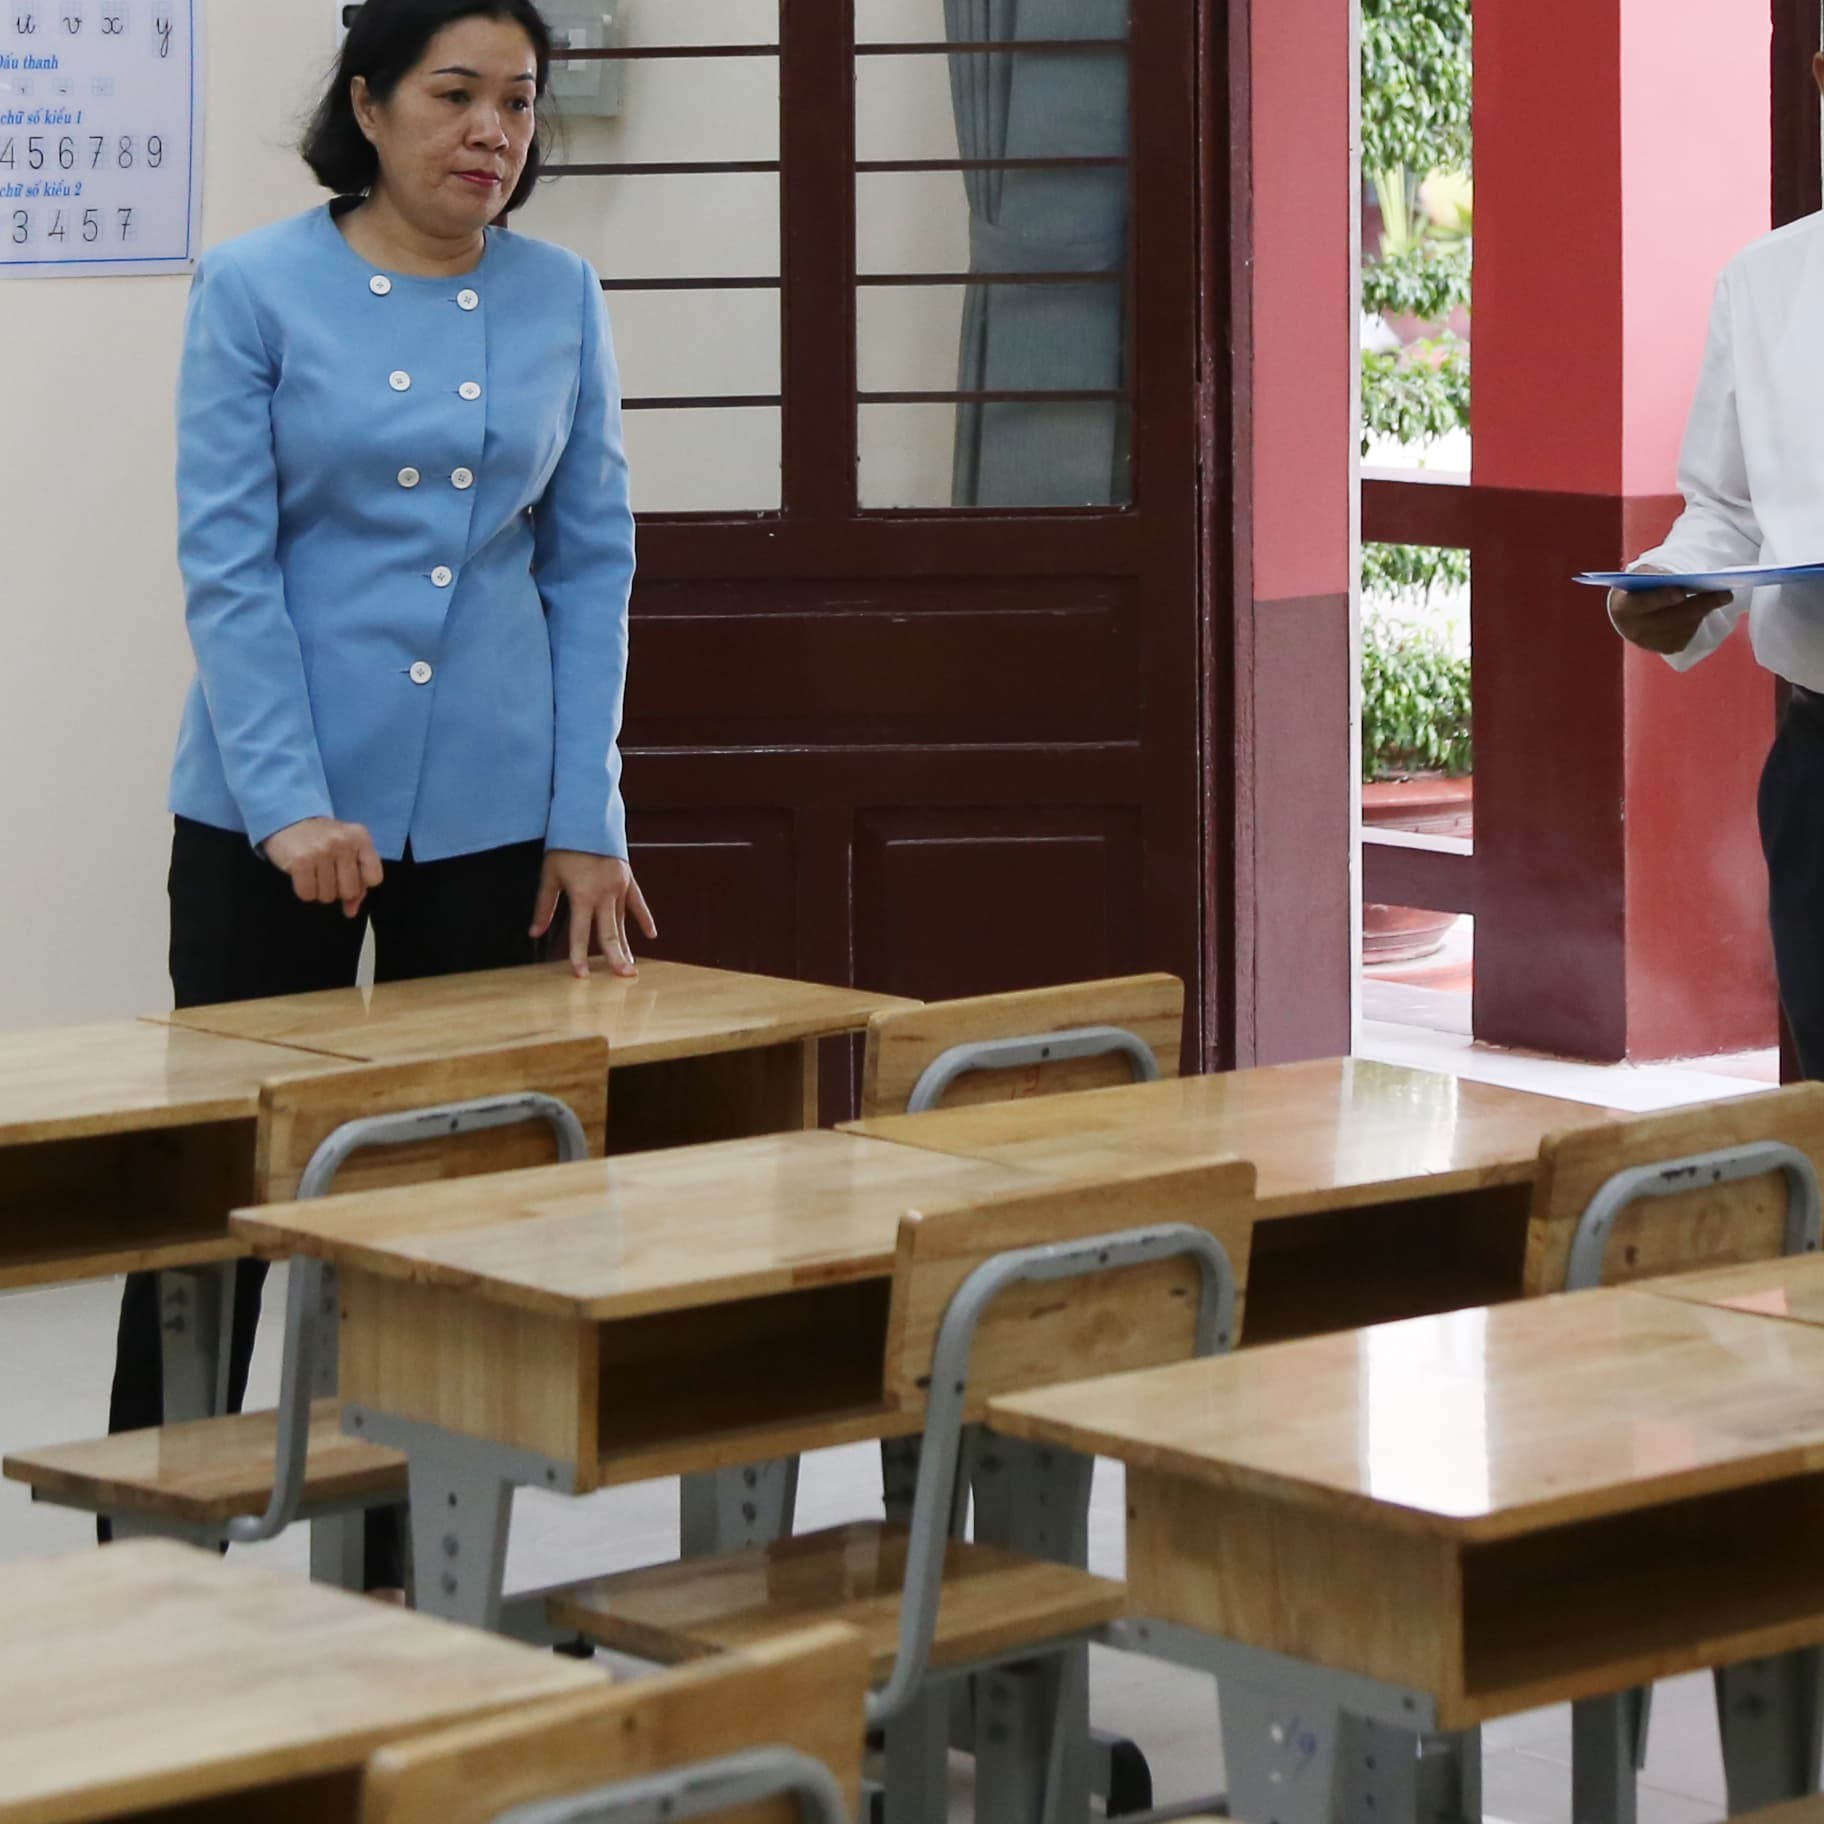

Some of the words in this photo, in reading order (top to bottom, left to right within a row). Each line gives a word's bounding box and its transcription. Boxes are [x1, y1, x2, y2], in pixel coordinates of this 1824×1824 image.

[23, 55, 59, 70] thanh
[28, 136, 44, 170] 5
[58, 136, 74, 170] 6
[88, 136, 104, 169] 7
[118, 135, 134, 169] 8
[147, 135, 163, 169] 9
[12, 209, 29, 244] 3
[47, 209, 66, 242] 4
[82, 208, 99, 242] 5
[117, 208, 133, 241] 7
